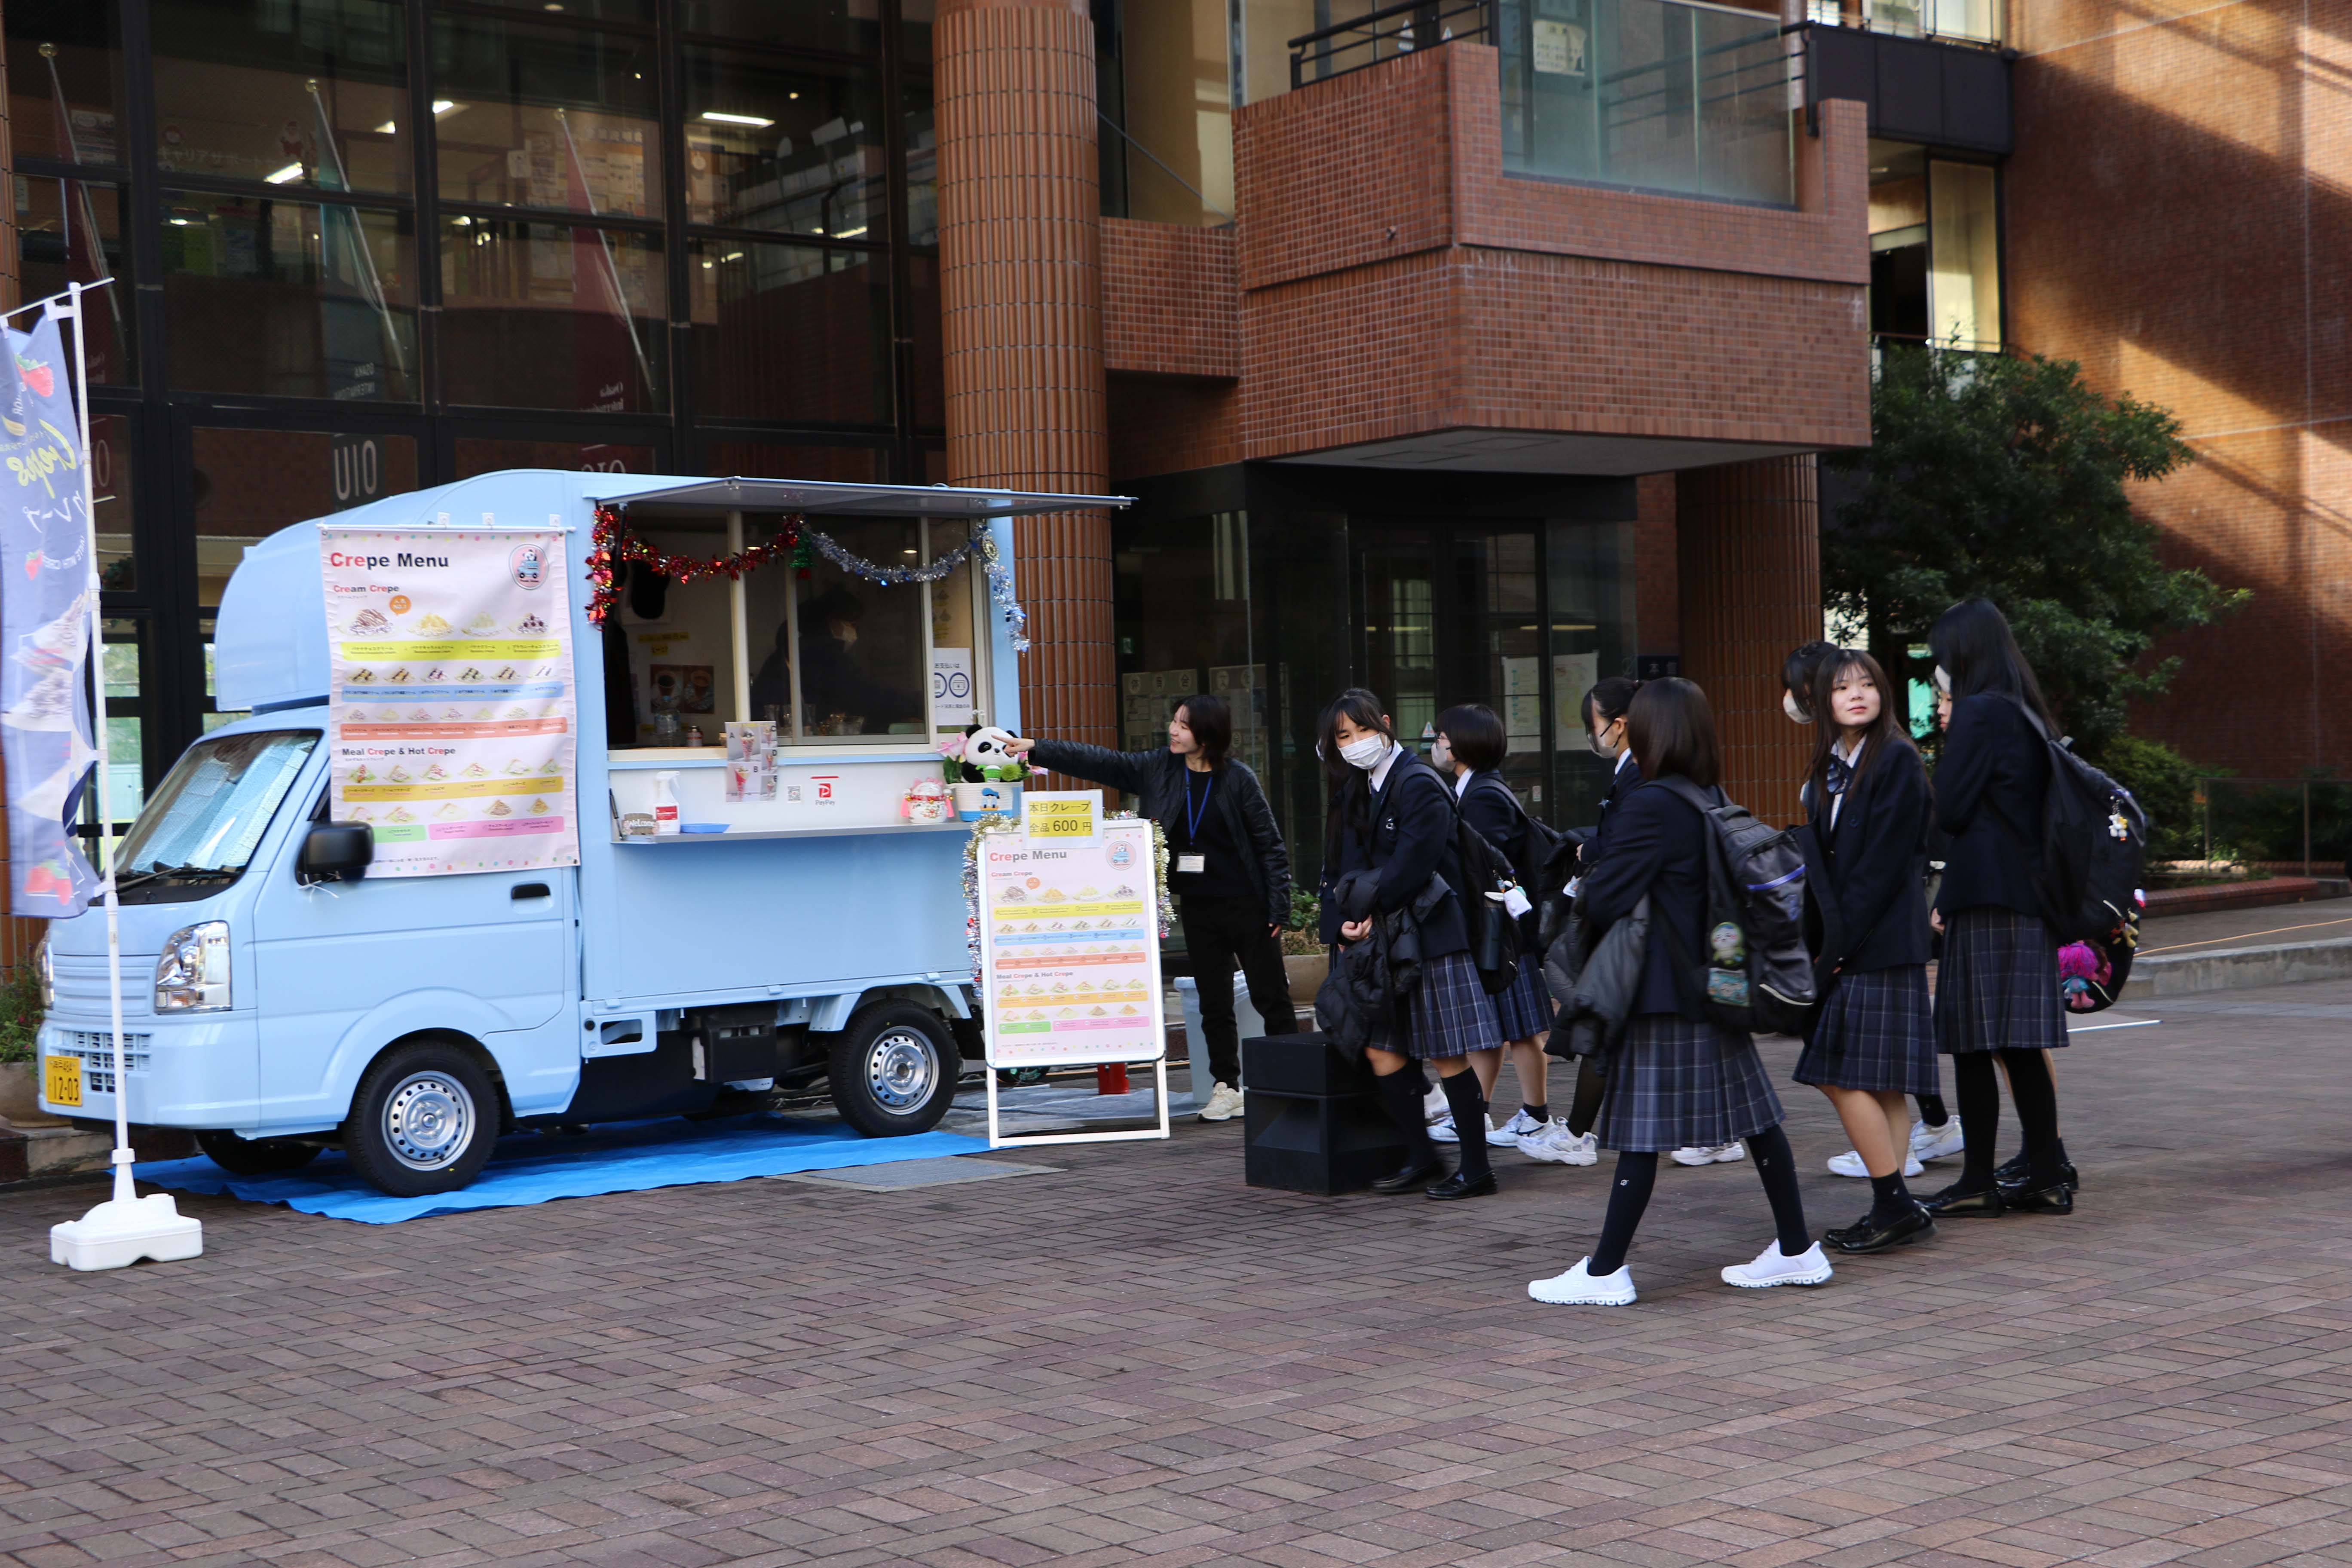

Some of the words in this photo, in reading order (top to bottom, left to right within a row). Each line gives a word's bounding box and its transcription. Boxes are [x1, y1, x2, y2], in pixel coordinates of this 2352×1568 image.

[330, 552, 390, 570] Crepe
[398, 553, 449, 567] Menu
[333, 585, 366, 593] Cream
[370, 584, 399, 595] Crepe
[428, 747, 456, 756] Crepe
[1029, 801, 1091, 813] 本日クレープ
[1029, 823, 1050, 833] 全品
[1053, 820, 1078, 832] 600
[1083, 823, 1092, 831] 円
[990, 852, 1028, 863] Crepe
[1032, 850, 1067, 860] Menu
